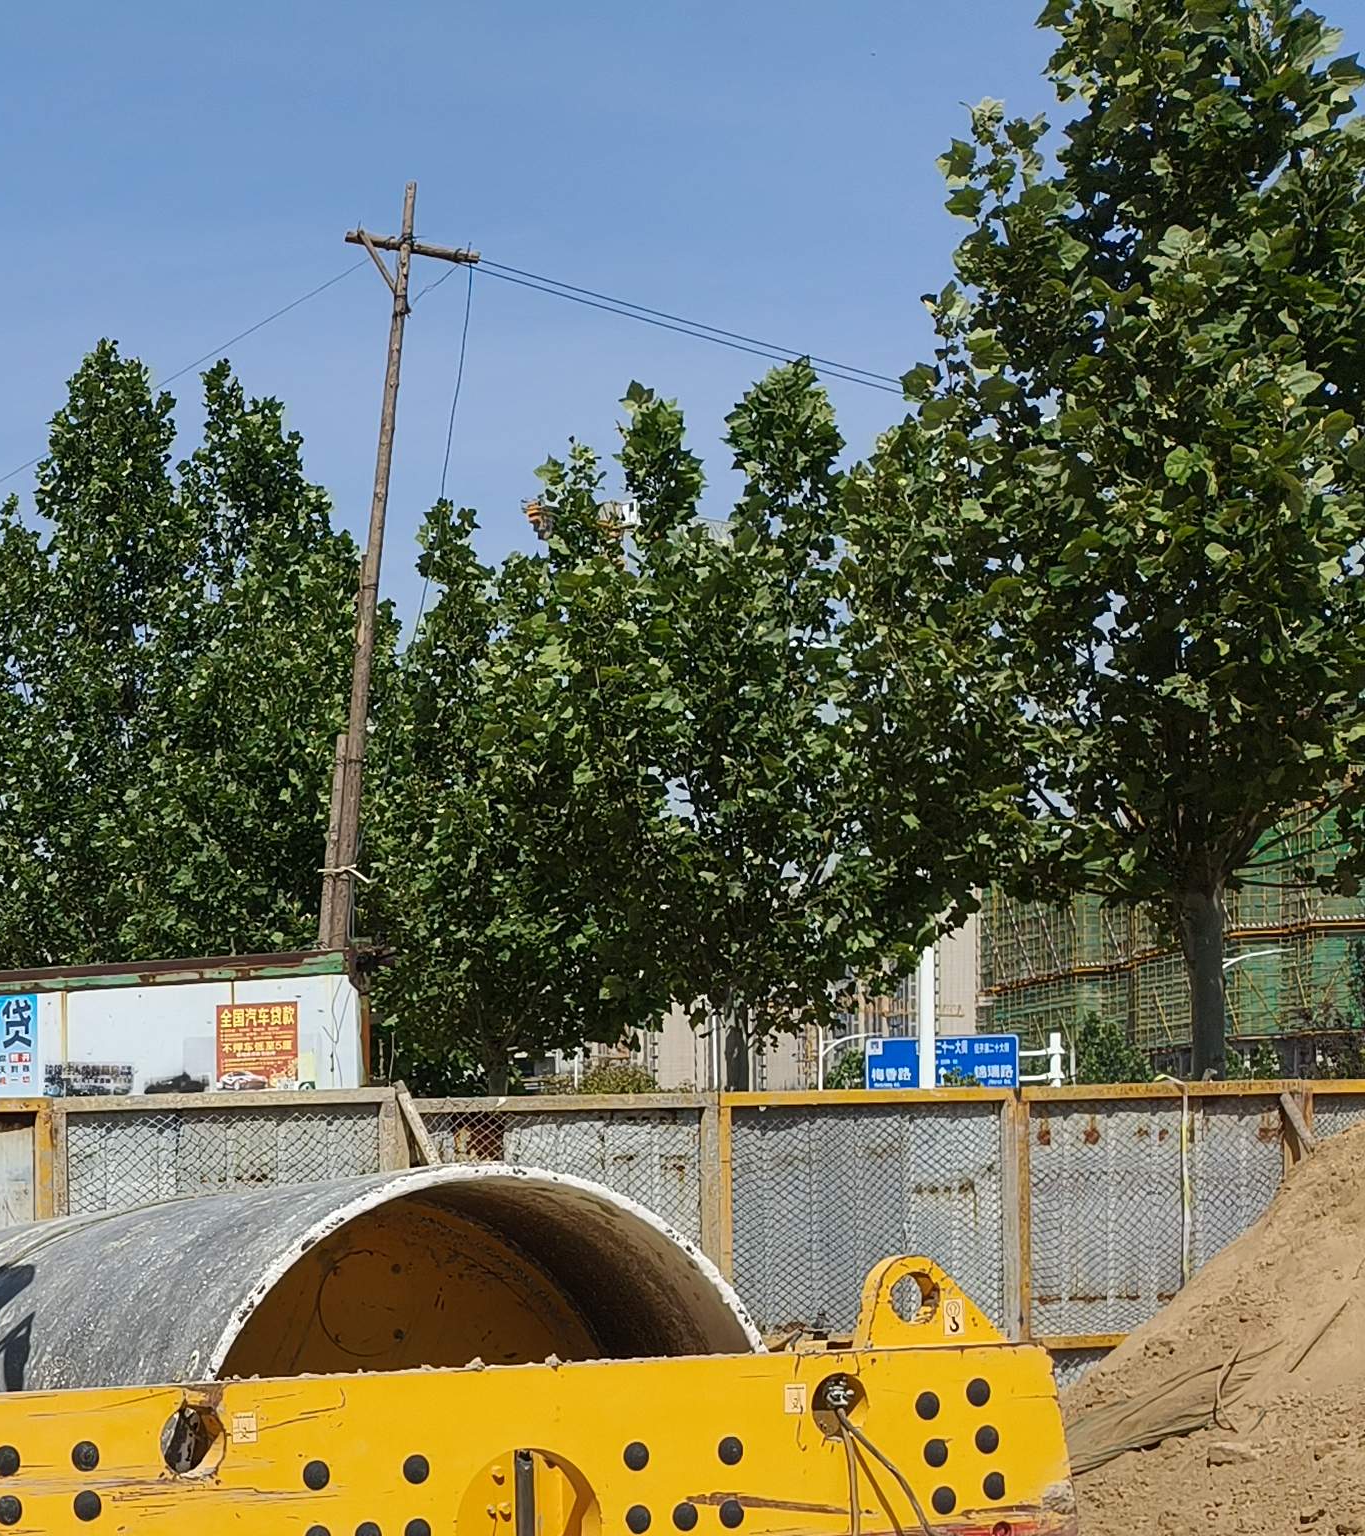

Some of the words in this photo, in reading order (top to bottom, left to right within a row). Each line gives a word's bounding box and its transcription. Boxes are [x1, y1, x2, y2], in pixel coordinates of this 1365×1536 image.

[220, 1006, 295, 1028] 全国汽车贷款
